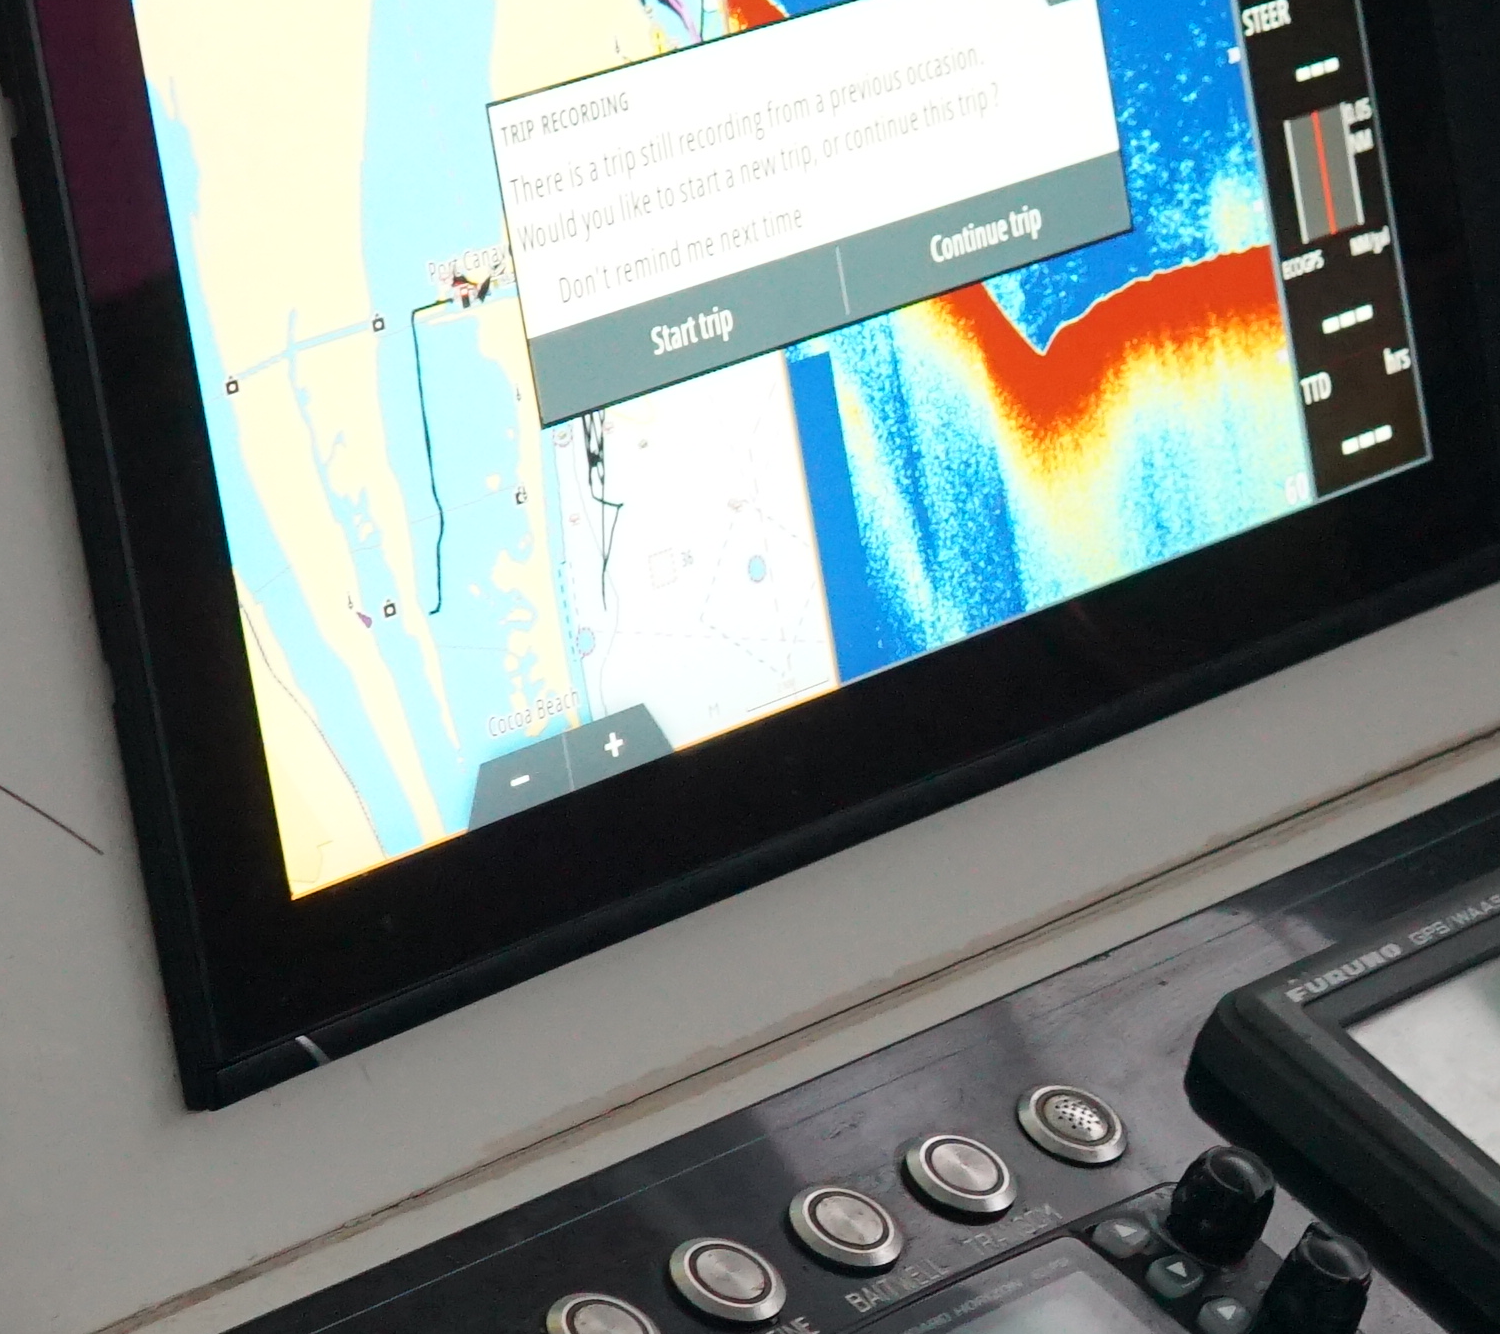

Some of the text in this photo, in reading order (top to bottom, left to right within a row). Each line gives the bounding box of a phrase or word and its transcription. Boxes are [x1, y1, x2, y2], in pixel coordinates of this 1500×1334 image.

[501, 91, 629, 147] TRIP RECORDING
[510, 46, 985, 206] There is a trip still recording from a previous occasion.
[517, 212, 577, 253] Would
[583, 204, 615, 238] you
[619, 188, 652, 222] like
[656, 186, 674, 211] to
[678, 173, 721, 203] start
[725, 168, 735, 187] a
[740, 155, 776, 184] new
[781, 143, 818, 177] trip,
[822, 135, 841, 158] or
[845, 108, 920, 150] continue
[923, 97, 955, 128] this
[958, 85, 989, 118] trip
[558, 204, 802, 304] Don't remind me next time
[930, 205, 1042, 263] Continue trip
[650, 306, 733, 355] Start trip
[1301, 372, 1331, 406] TTD
[1383, 348, 1411, 375] hrs
[1284, 472, 1309, 506] 60
[488, 688, 582, 739] Cocoa Beach
[1285, 943, 1402, 1003] FURUNO
